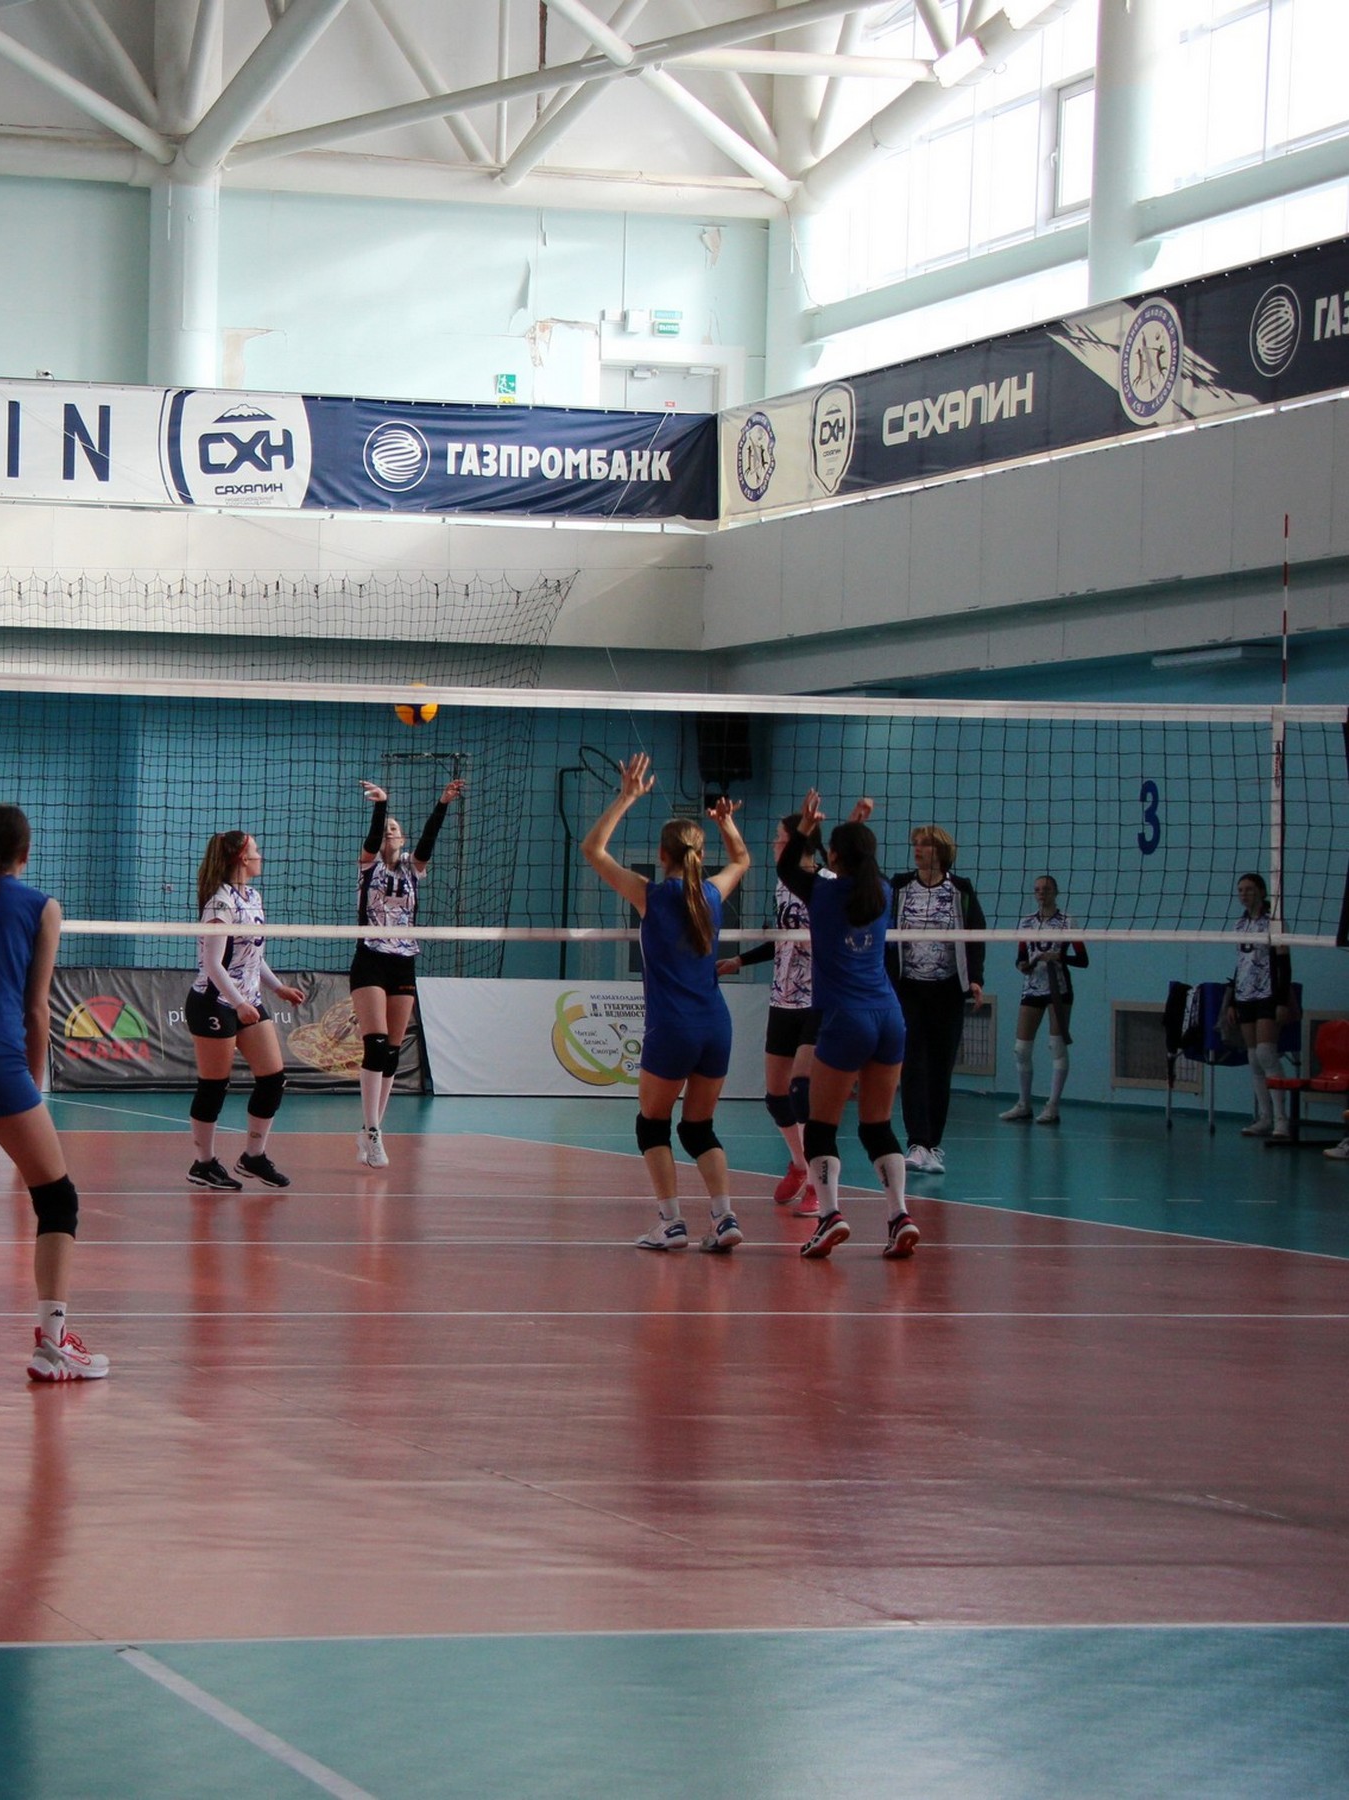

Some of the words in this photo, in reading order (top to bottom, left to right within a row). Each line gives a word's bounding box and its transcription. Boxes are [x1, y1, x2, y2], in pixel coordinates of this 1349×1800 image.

[882, 371, 1035, 447] САХАЛИН
[446, 442, 672, 482] ГАЗПРОМБАНК
[214, 483, 284, 496] САХАЛИН
[1137, 780, 1161, 856] 3
[208, 1016, 222, 1031] 3
[604, 1010, 646, 1018] ВЕДОМОСТ
